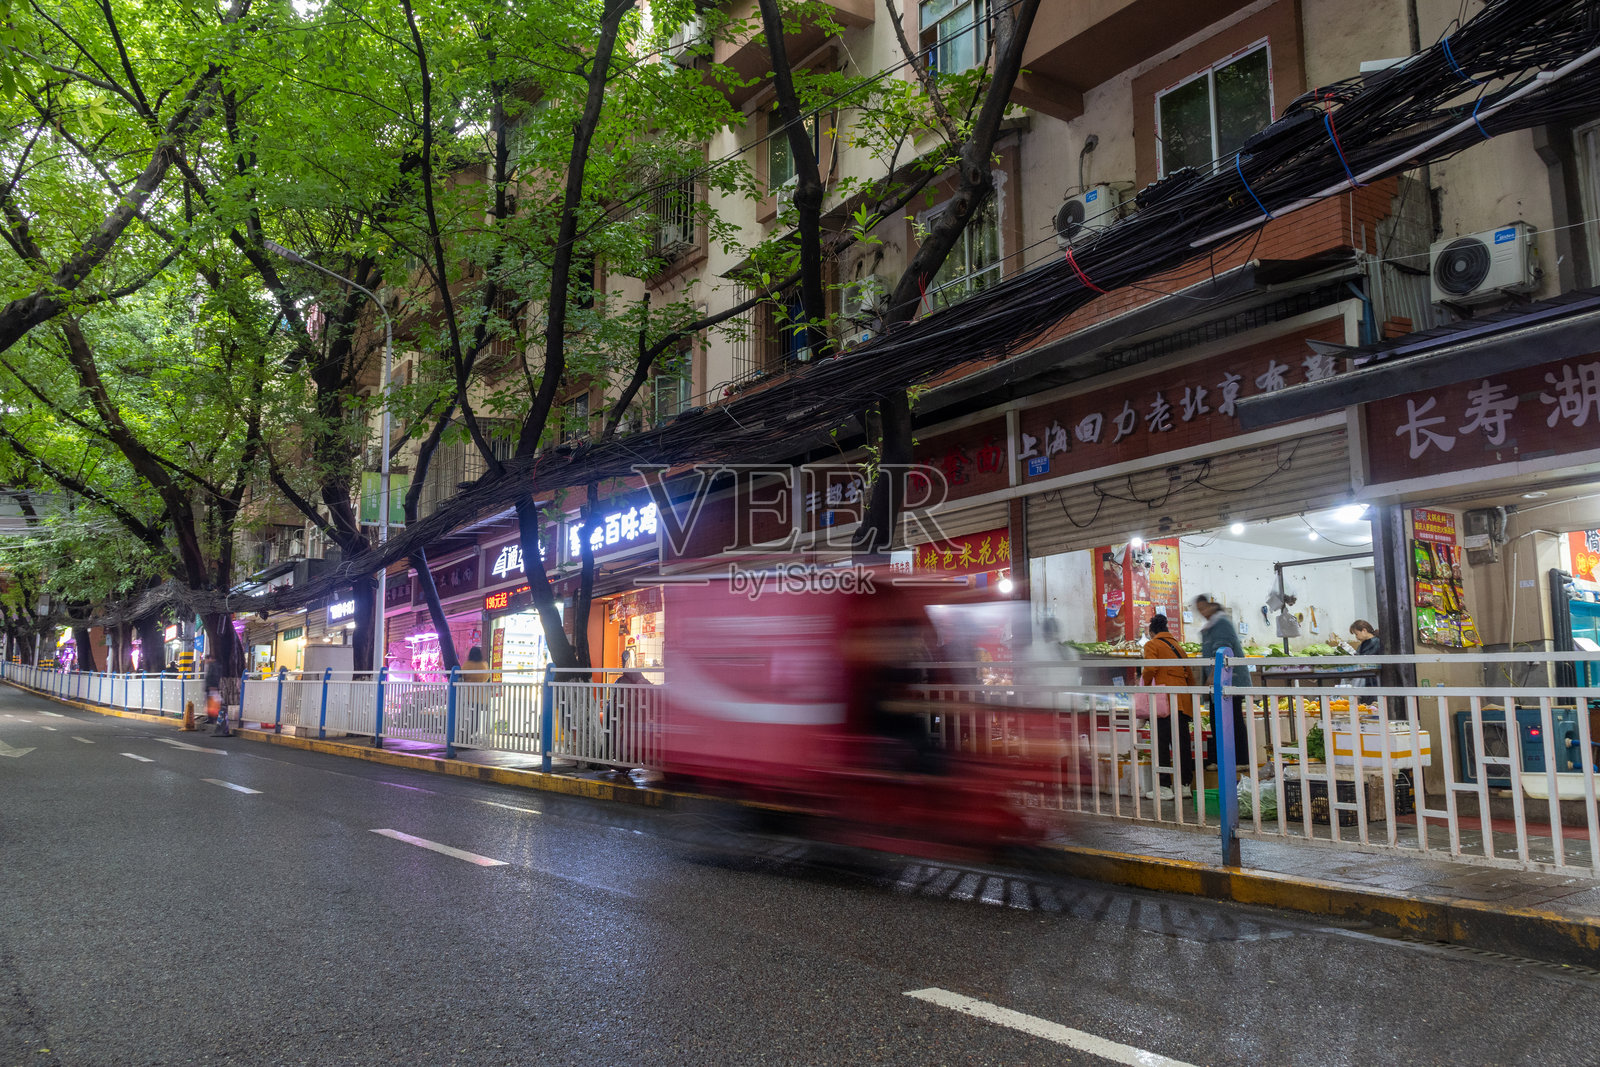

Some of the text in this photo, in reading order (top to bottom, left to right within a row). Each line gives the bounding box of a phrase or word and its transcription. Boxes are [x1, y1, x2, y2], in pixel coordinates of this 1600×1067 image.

[1017, 355, 1339, 459] 上海回力老北京布鞋
[1396, 361, 1600, 460] 长寿湖
